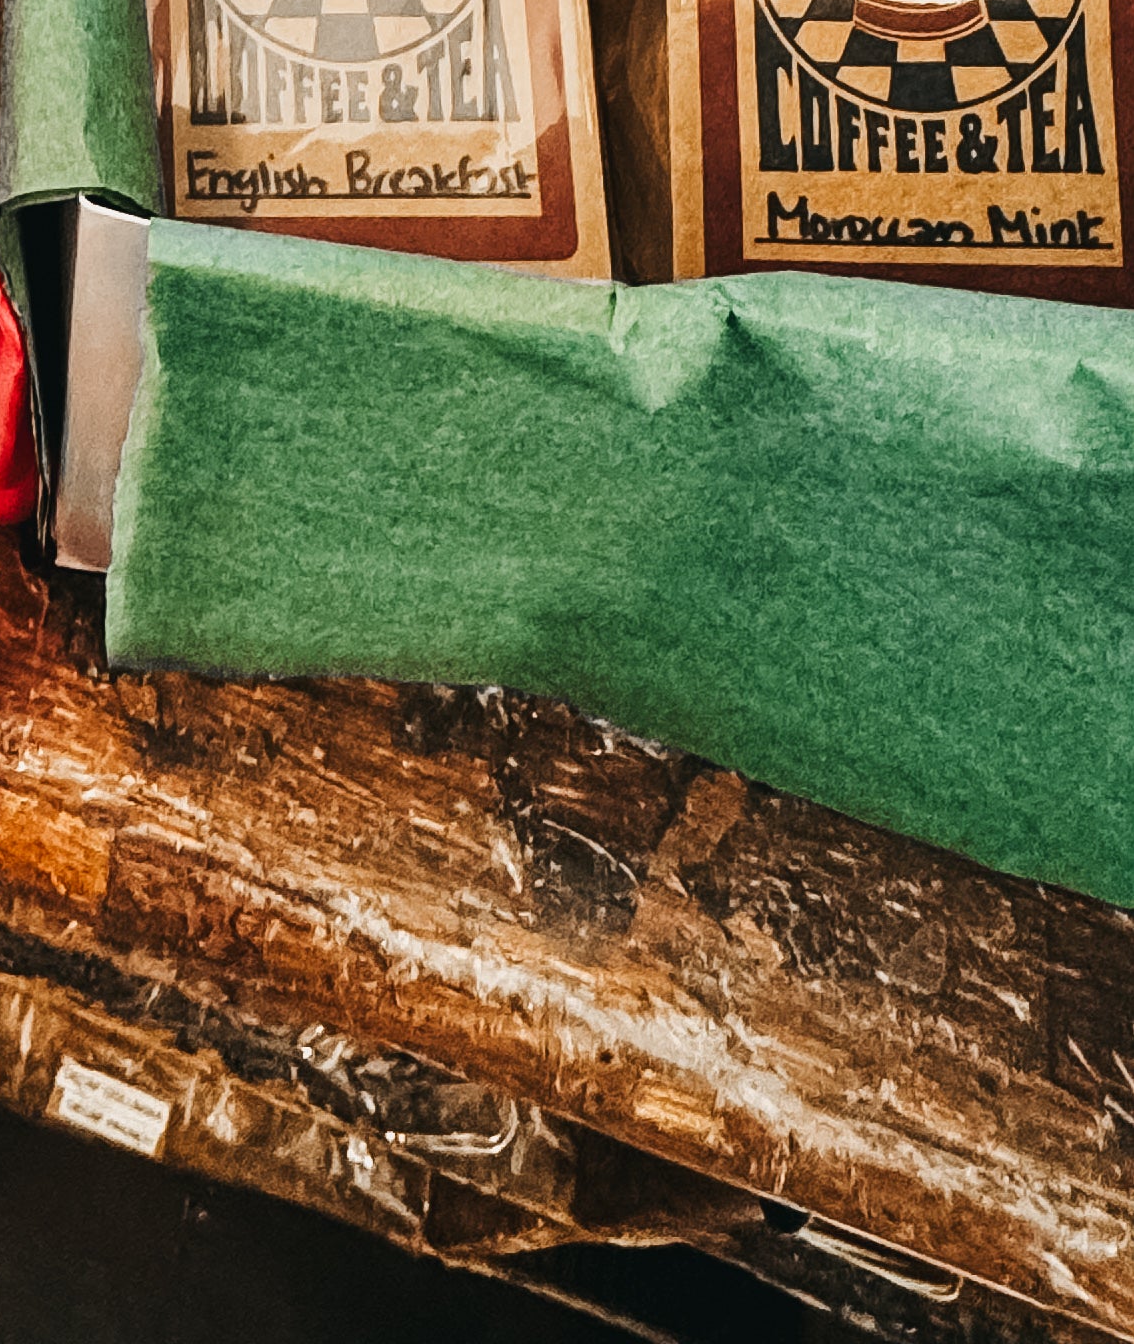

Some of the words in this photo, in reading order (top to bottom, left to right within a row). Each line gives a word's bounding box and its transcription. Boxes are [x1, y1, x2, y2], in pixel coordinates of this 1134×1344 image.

[187, 150, 325, 212] English
[345, 149, 537, 197] Breakfast
[987, 203, 1103, 247] Mint
